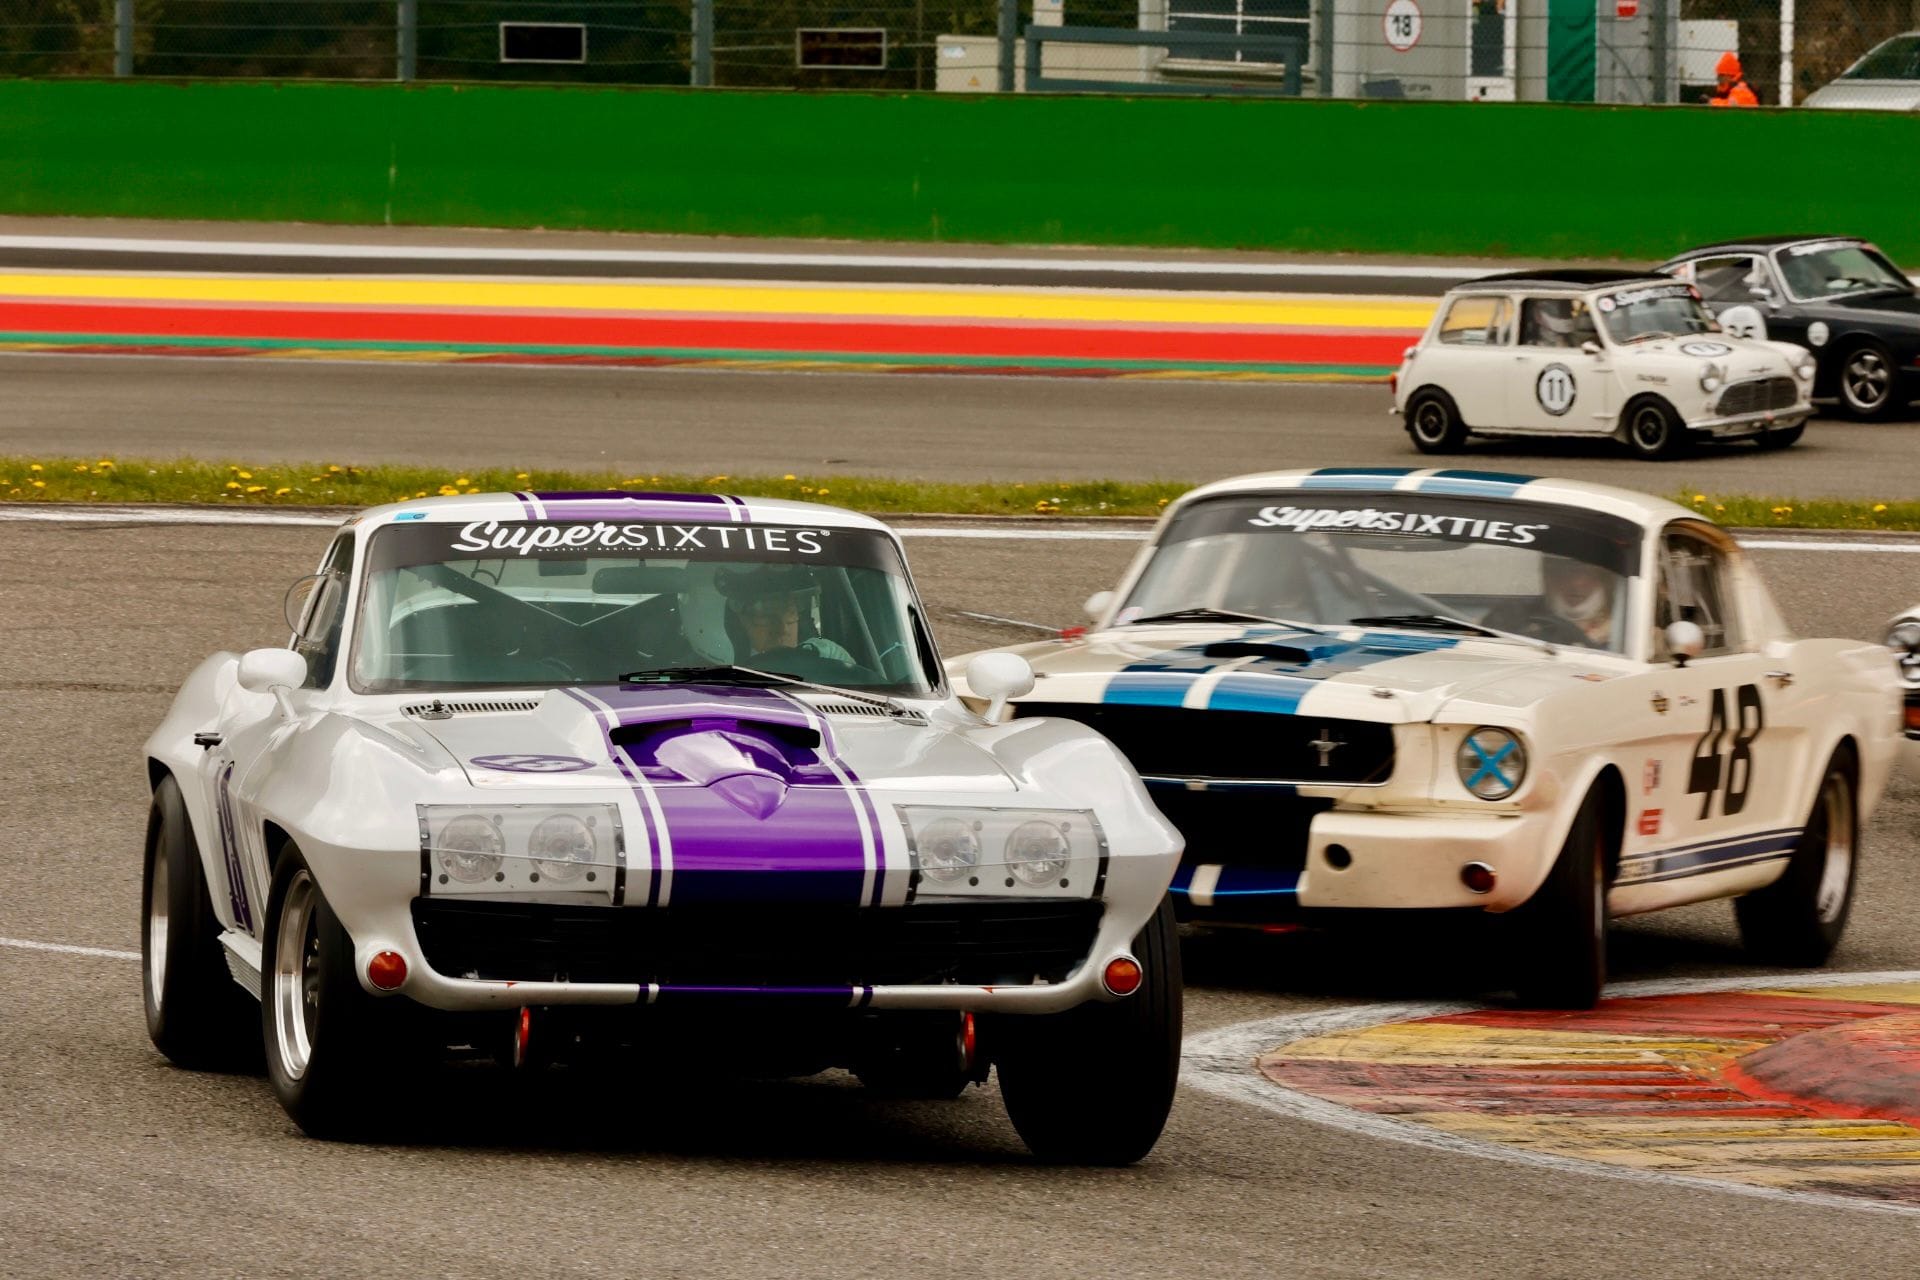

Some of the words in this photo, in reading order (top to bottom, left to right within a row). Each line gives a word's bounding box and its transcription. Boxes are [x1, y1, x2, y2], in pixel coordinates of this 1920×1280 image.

[1392, 15, 1411, 36] 18
[1547, 377, 1565, 401] 11
[1686, 683, 1763, 821] 48
